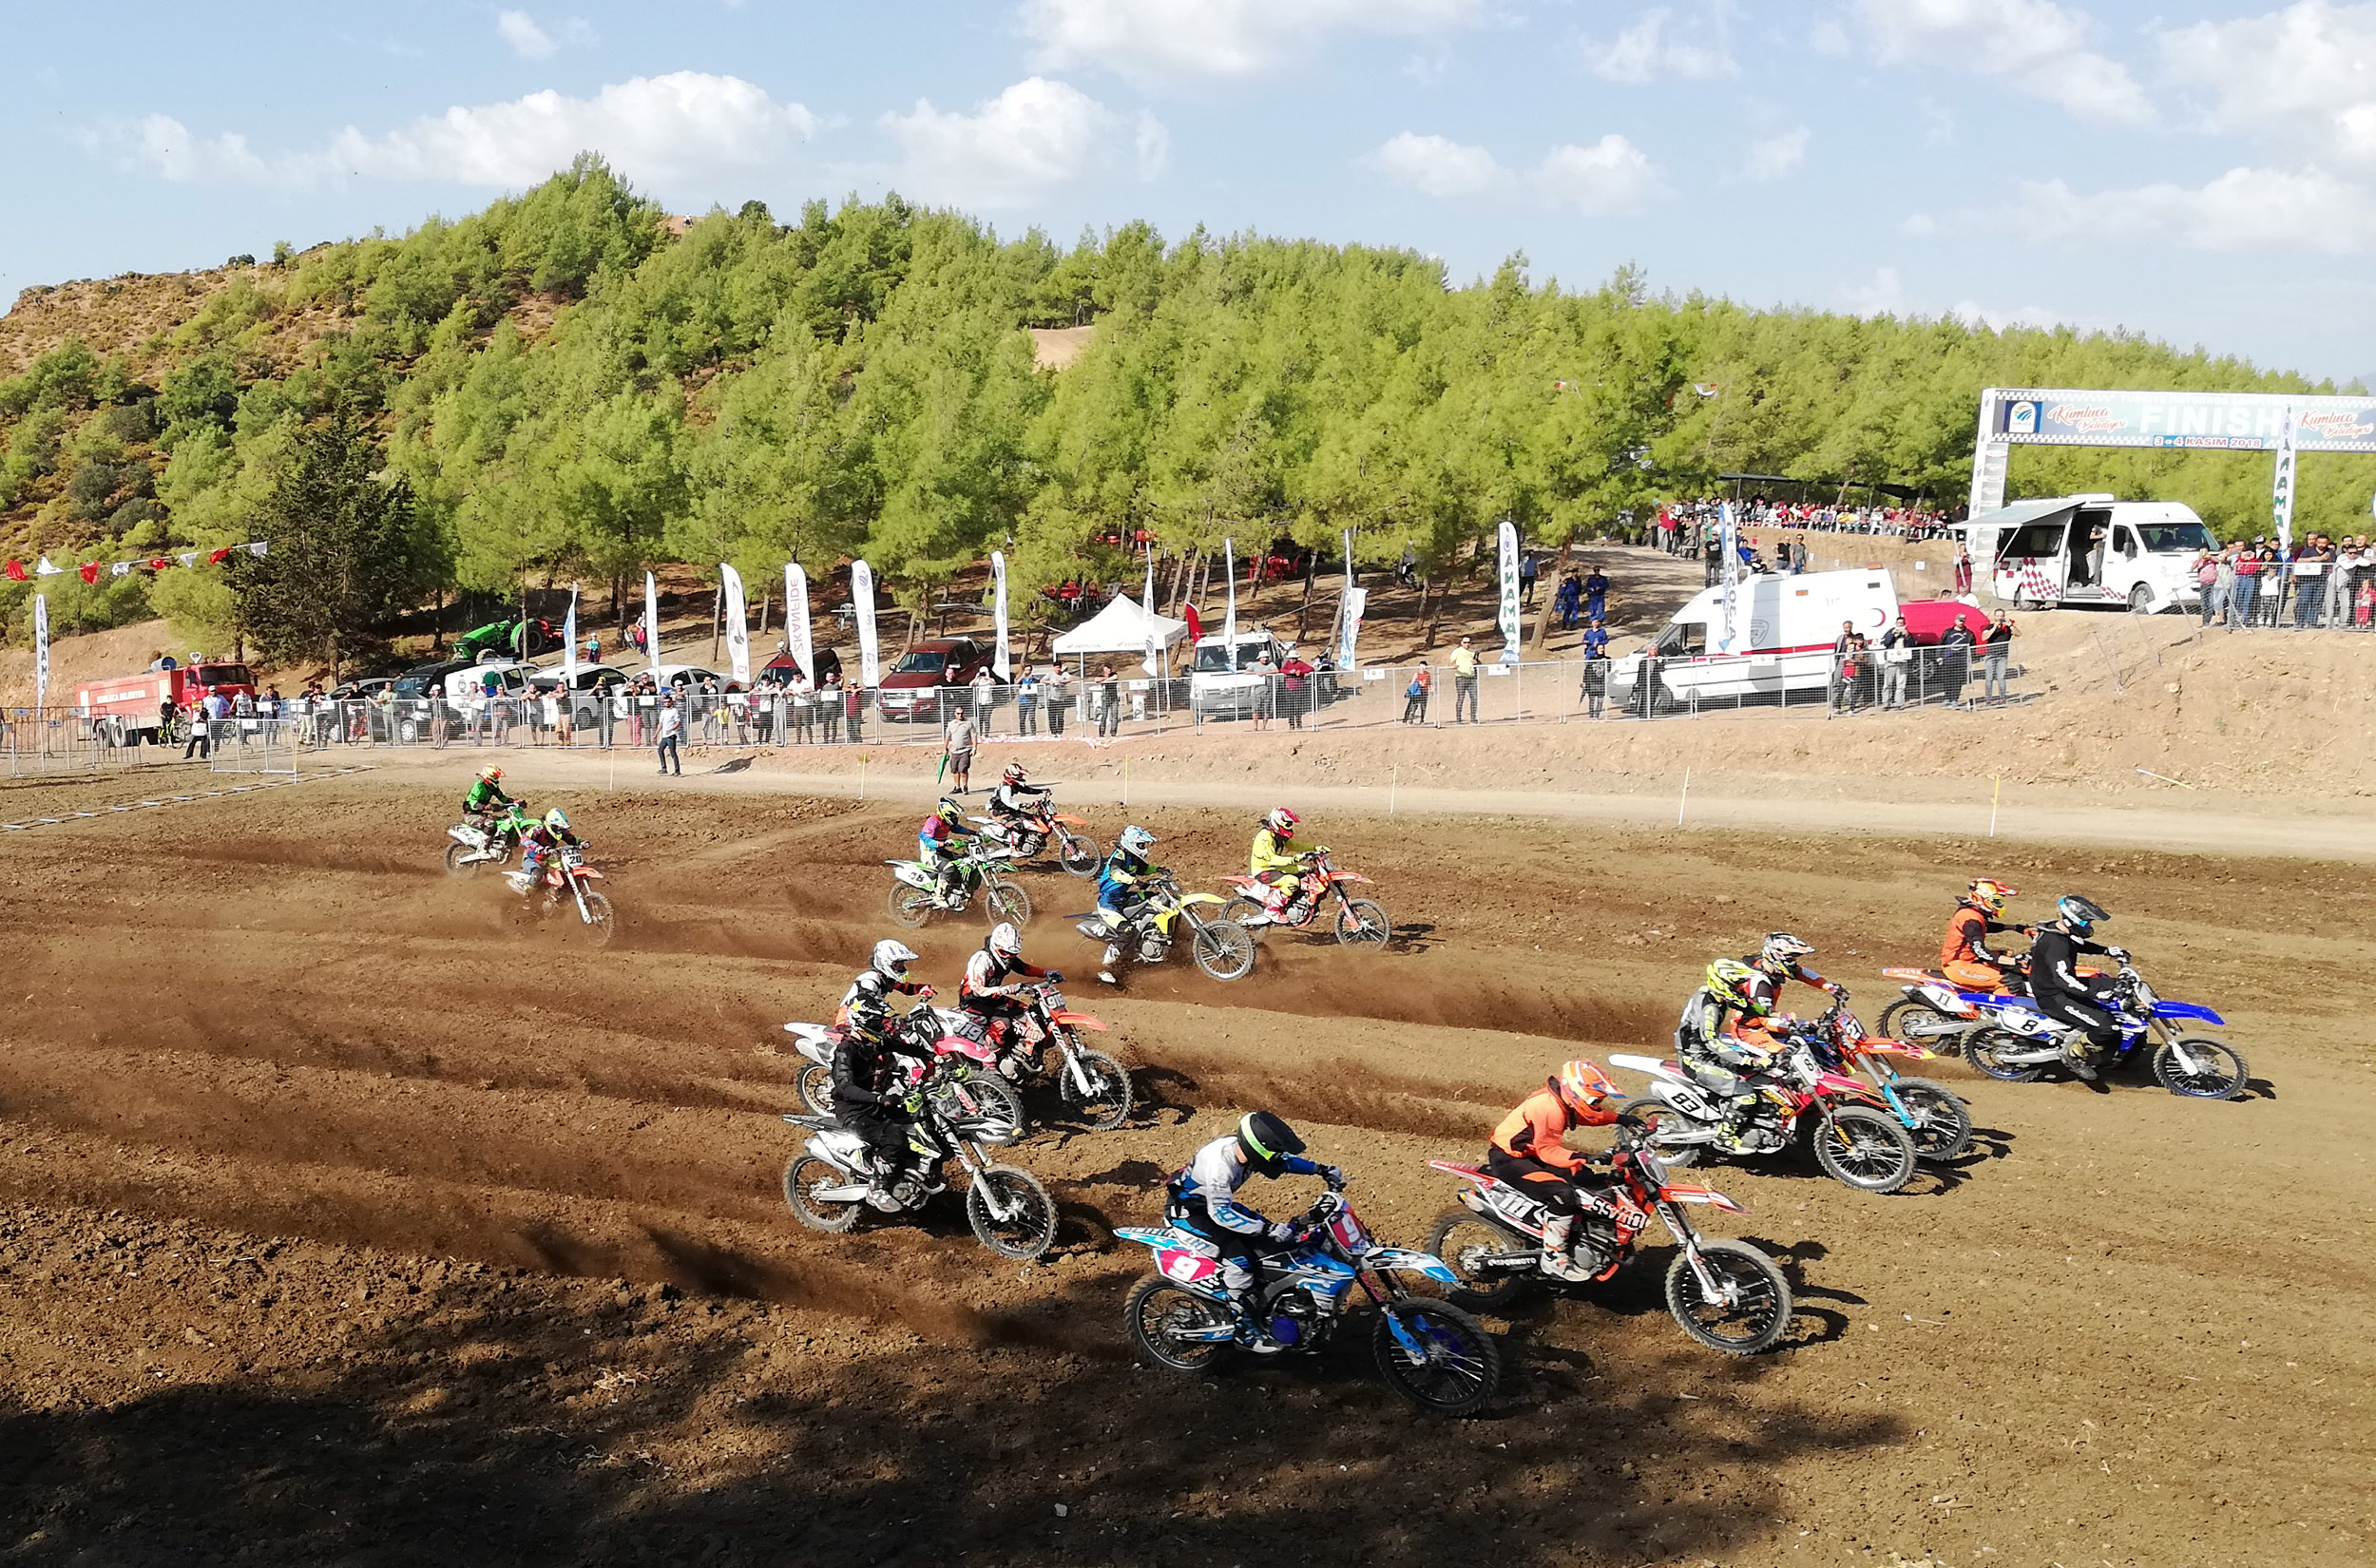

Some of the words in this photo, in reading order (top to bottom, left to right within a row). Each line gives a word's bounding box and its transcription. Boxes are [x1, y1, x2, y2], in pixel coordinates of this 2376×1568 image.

[2047, 405, 2110, 425] Kumluca
[2139, 404, 2281, 437] FINISH
[2295, 411, 2358, 430] Kumluca
[2186, 438, 2227, 447] KASIM
[2231, 439, 2262, 448] 2018
[1090, 923, 1106, 937] 40
[1046, 993, 1065, 1008] 919
[1936, 991, 1951, 1007] 11
[953, 1020, 984, 1042] 919
[1846, 1018, 1864, 1040] 27
[2021, 1019, 2039, 1031] 8
[941, 1098, 956, 1114] 26
[1671, 1092, 1701, 1113] 83
[1342, 1213, 1360, 1244] 9
[1167, 1254, 1201, 1282] 9
